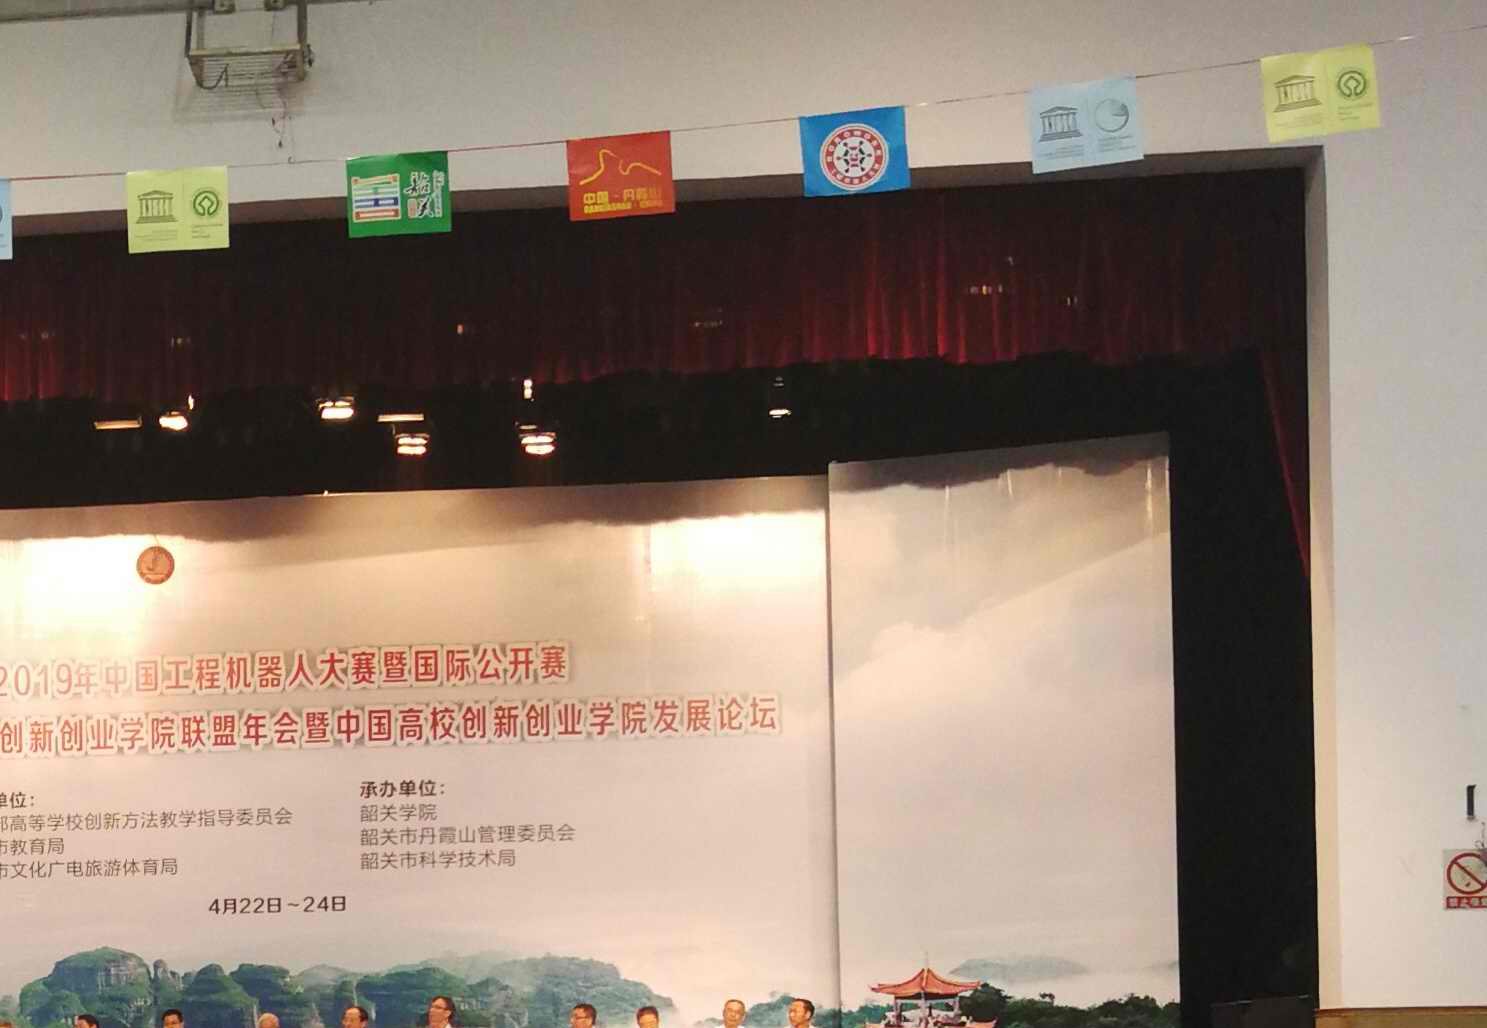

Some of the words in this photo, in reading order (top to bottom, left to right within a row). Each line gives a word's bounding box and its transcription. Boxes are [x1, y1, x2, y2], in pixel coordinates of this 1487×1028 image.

[359, 780, 445, 799] 承办单位：
[359, 803, 438, 823] 韶关学院
[359, 823, 576, 848] 韶关市丹霞山管理委员会
[359, 849, 517, 870] 韶关市科学技术局
